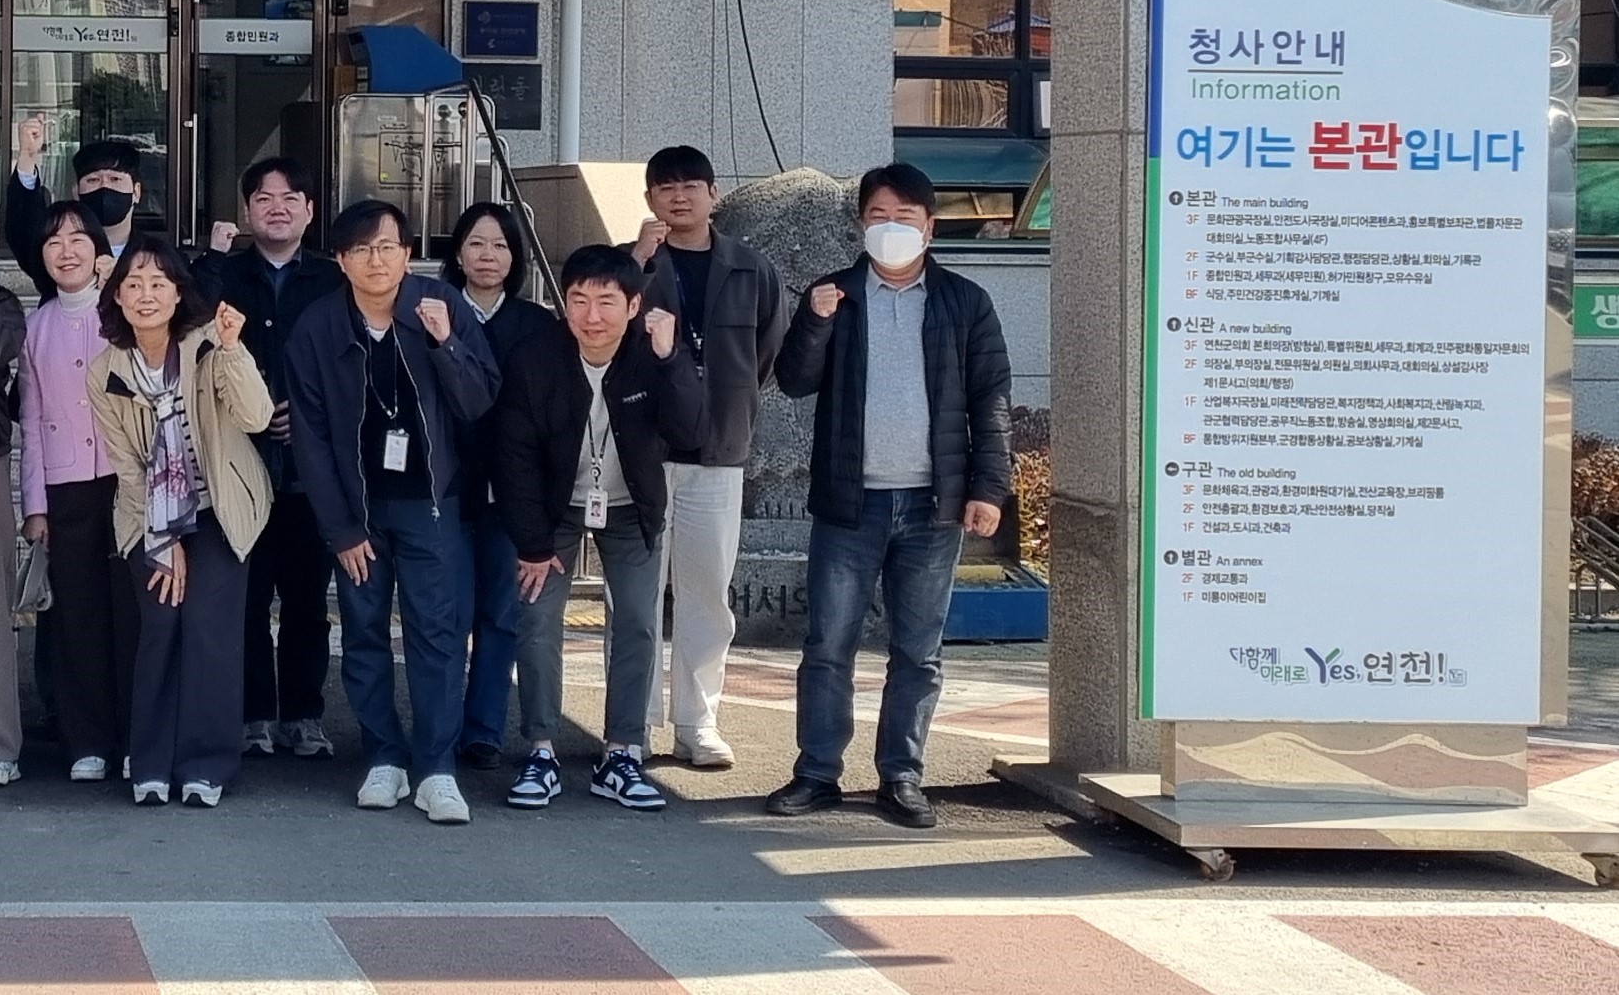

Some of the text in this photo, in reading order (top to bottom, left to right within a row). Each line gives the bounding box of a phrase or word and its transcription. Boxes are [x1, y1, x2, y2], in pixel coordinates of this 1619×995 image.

[225, 30, 280, 43] 종합민원과
[1188, 28, 1345, 66] 청사안내
[1191, 77, 1341, 101] Information
[1176, 121, 1525, 173] 여기는 본관입니다
[1185, 189, 1309, 210] 본관 The main building
[1185, 213, 1200, 225] 3F
[1185, 251, 1199, 262] 2F
[1185, 270, 1199, 281] 1F
[1185, 289, 1199, 299] BF
[1183, 316, 1293, 336] 신관 A new building
[1184, 339, 1198, 350] 3F
[1184, 358, 1198, 369] 2F
[1184, 396, 1197, 406] 1F
[1183, 433, 1197, 444] BF
[1181, 461, 1297, 481] 구관 The old building
[1182, 484, 1195, 495] 3F
[1182, 503, 1195, 514] 2F
[1182, 522, 1195, 532] 1F
[1181, 549, 1263, 567] 별관 An annex
[1182, 572, 1248, 585] 2F 경제교통과
[1182, 591, 1194, 602] 1F
[1229, 646, 1278, 670] 다함께
[1260, 664, 1307, 683] 미래로
[1304, 647, 1361, 684] Yes,
[1363, 651, 1445, 684] 연천!
